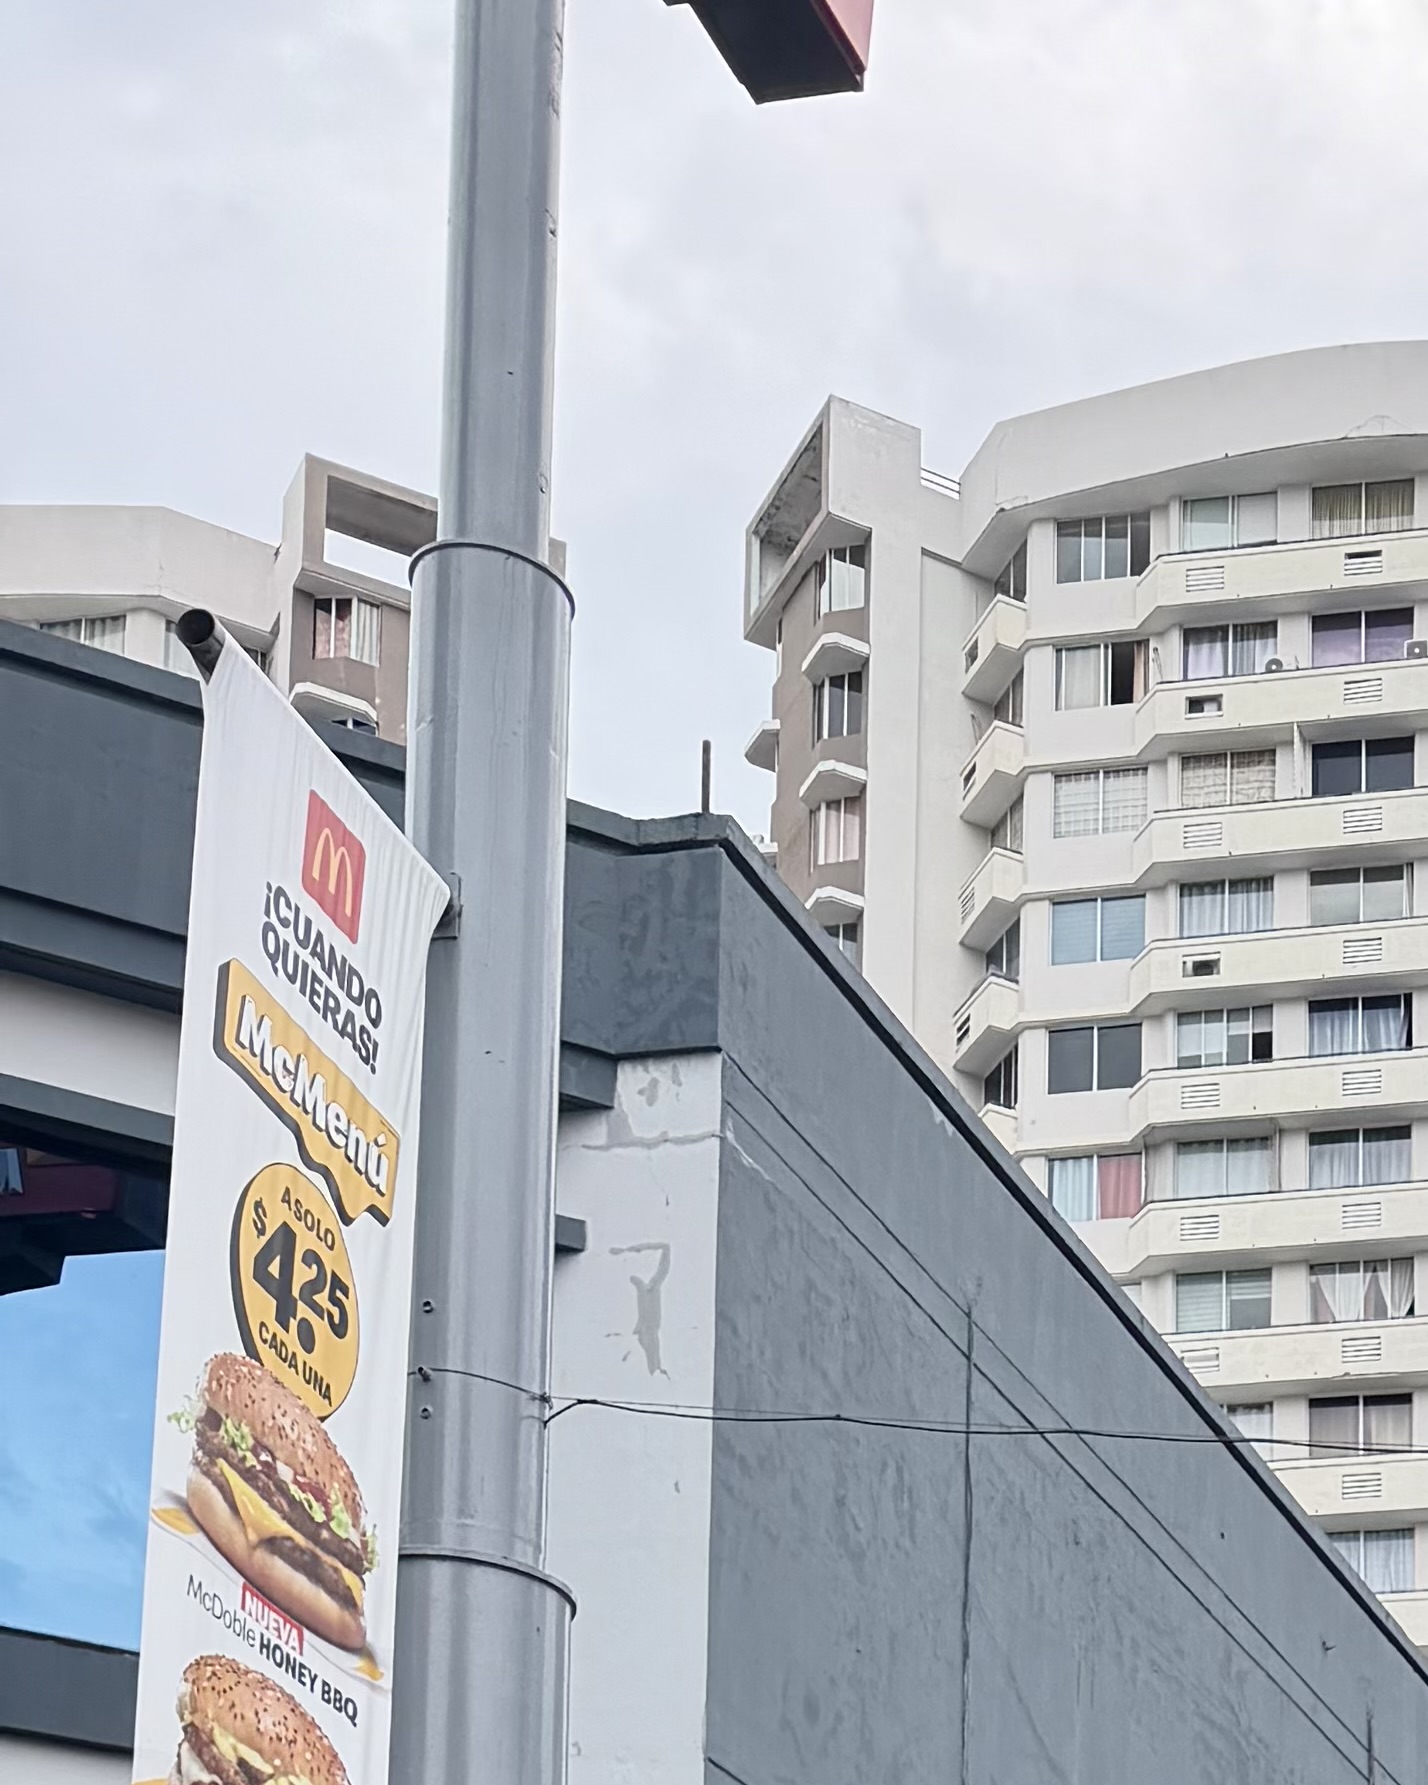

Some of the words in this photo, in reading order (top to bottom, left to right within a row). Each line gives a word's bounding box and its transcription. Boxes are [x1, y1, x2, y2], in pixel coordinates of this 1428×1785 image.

[261, 921, 378, 1076] QUIERAS!
[263, 881, 383, 1030] ¡CUANDO
[234, 993, 390, 1198] McMenú
[258, 1320, 299, 1377] CADA
[302, 1358, 333, 1408] UNA
[186, 1574, 256, 1648] McDoble
[259, 1631, 318, 1694] HONEY
[320, 1678, 358, 1728] BBQ
[244, 1589, 301, 1656] NUEVA
